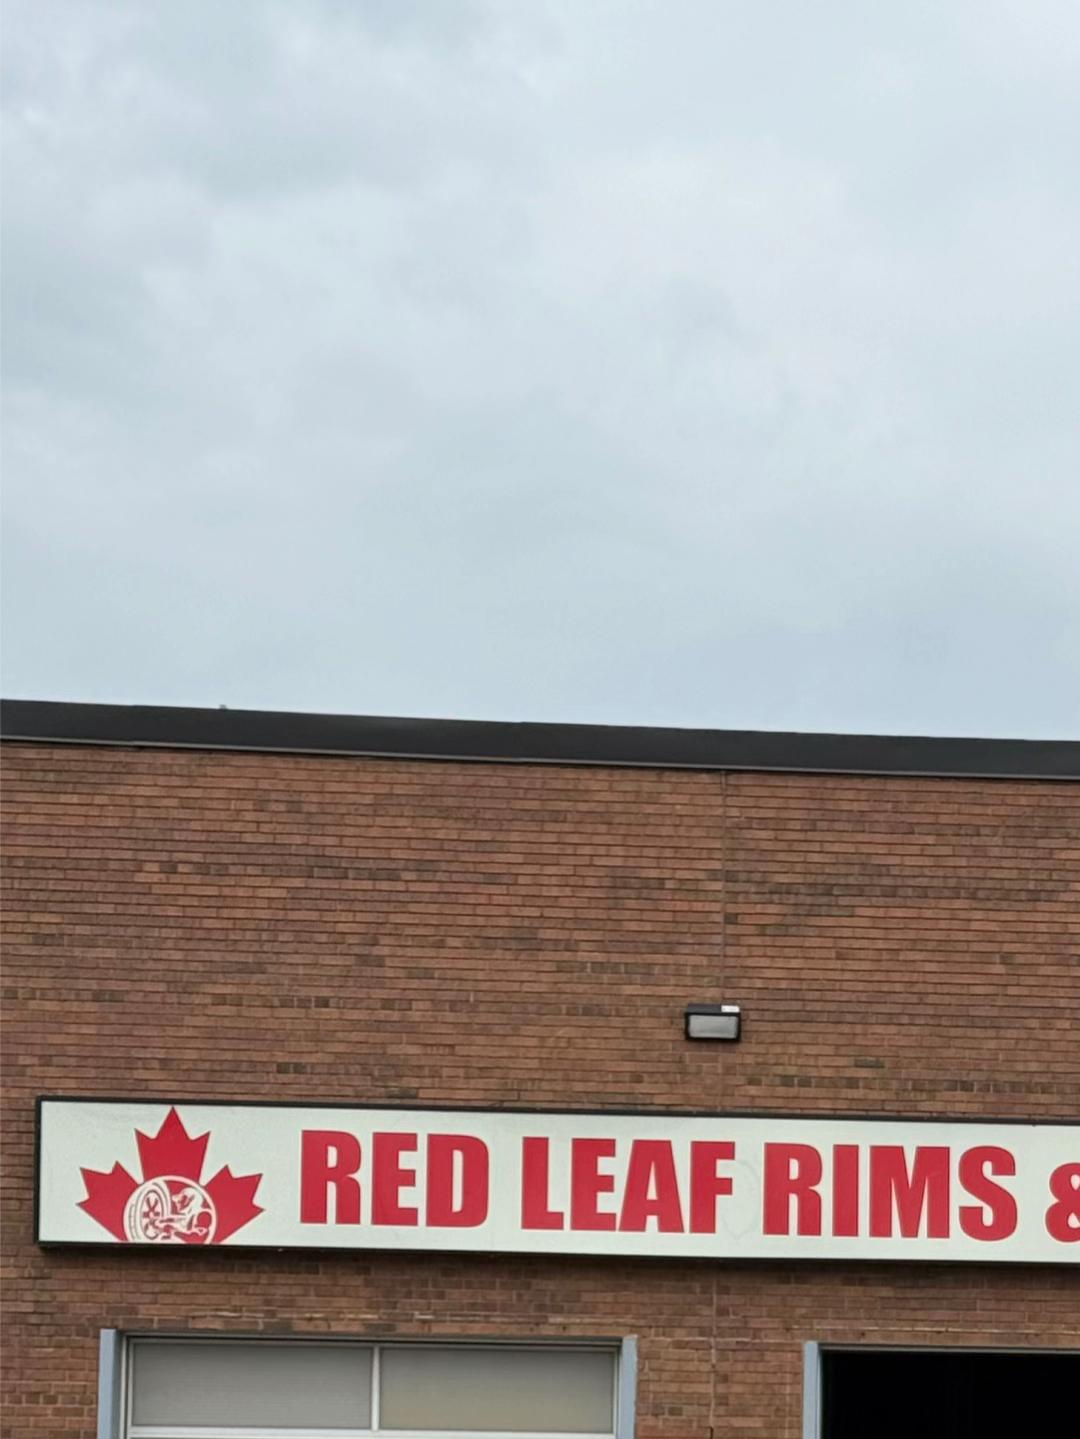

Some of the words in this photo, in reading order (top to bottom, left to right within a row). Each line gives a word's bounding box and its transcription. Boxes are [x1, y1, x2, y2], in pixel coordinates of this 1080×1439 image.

[300, 1129, 490, 1228] RED
[521, 1136, 736, 1234] LEAF
[763, 1142, 1018, 1242] RIMS
